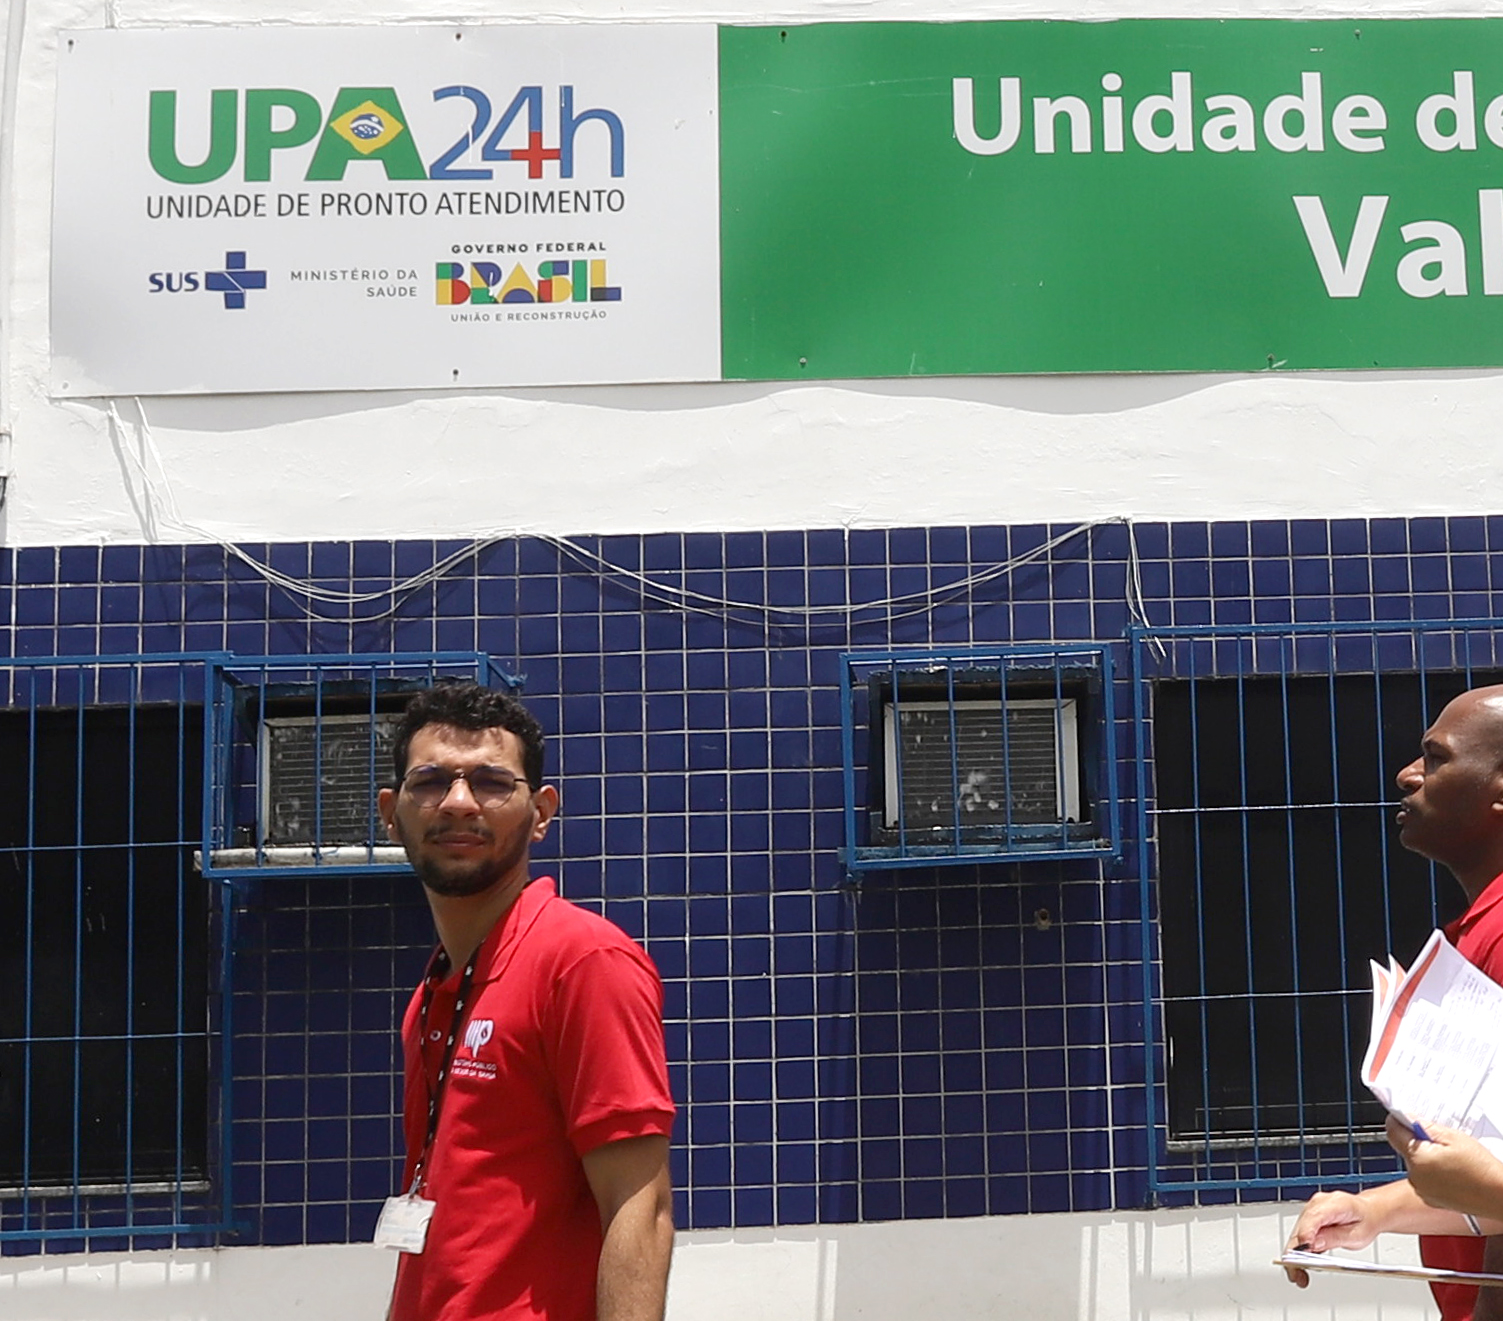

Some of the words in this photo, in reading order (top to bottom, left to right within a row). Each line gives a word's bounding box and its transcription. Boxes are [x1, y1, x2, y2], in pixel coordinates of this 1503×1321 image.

[951, 70, 1389, 157] Unidade
[146, 194, 267, 219] UNIDADE
[276, 193, 310, 217] DE
[321, 192, 428, 216] PRONTO
[434, 189, 625, 215] ATENDIMENTO
[450, 243, 529, 255] GOVERNO
[535, 241, 607, 253] FEDERAL
[148, 271, 200, 293] SUS
[290, 267, 389, 281] MINISTÉRIO
[396, 268, 418, 280] DA
[435, 259, 622, 306] BRASIL
[366, 285, 417, 298] SAÚDE
[450, 311, 491, 323] UNIÃO
[495, 313, 502, 322] E
[507, 309, 607, 323] RECONSTRUÇÃO
